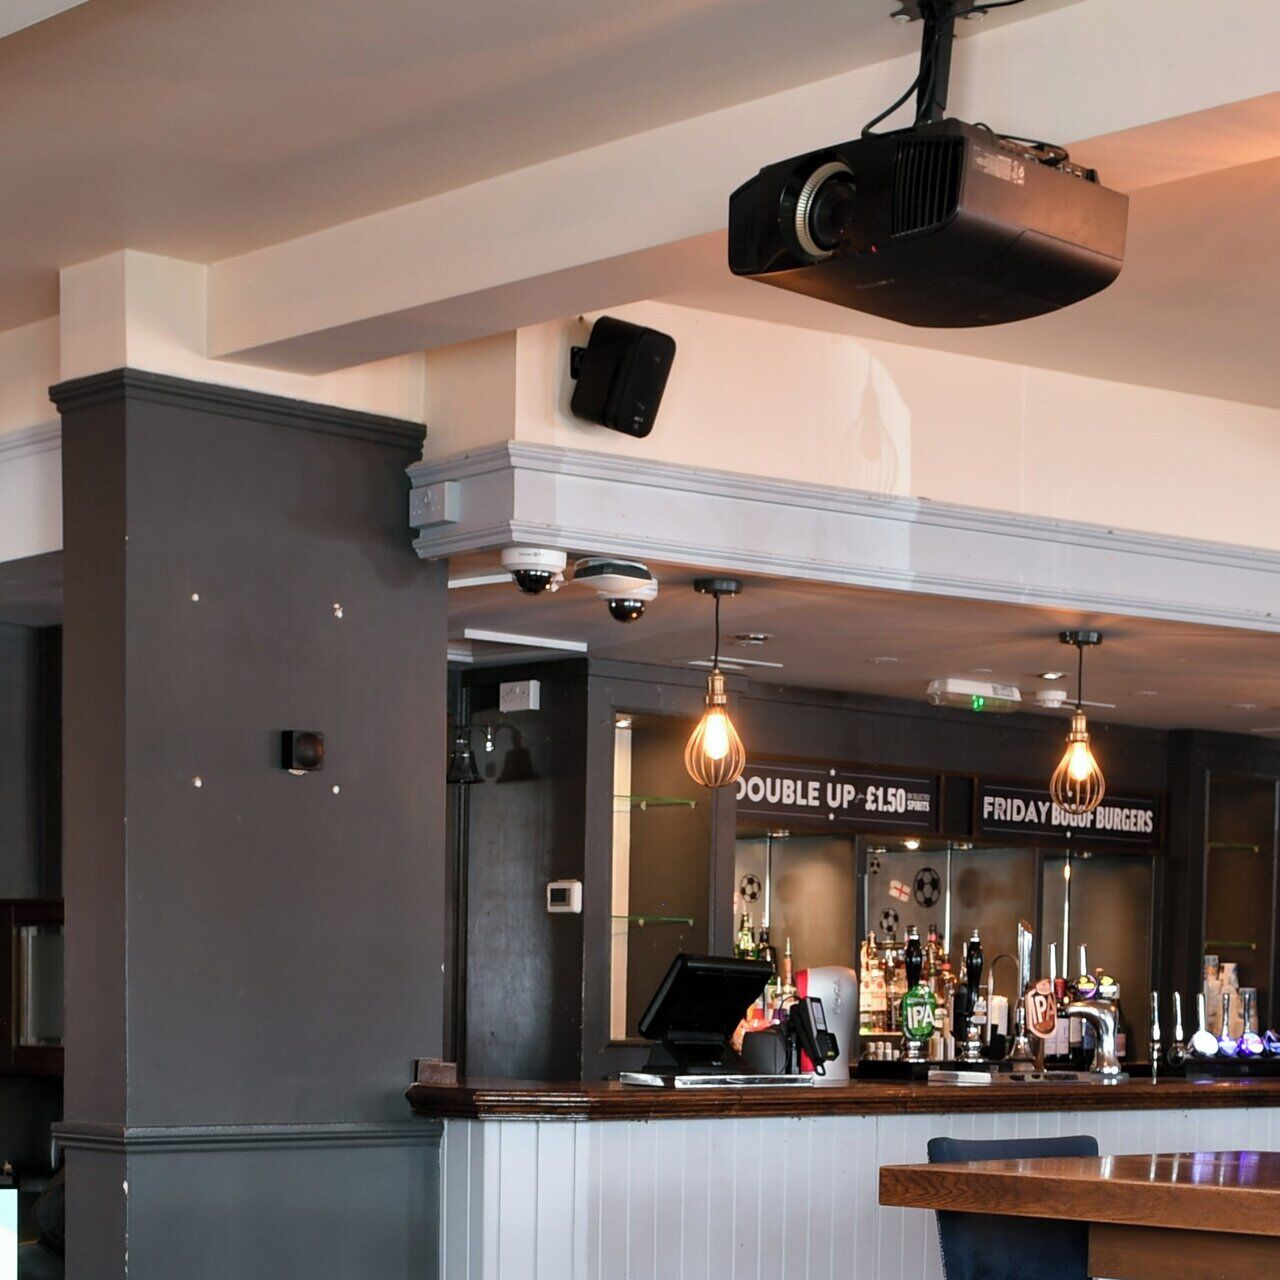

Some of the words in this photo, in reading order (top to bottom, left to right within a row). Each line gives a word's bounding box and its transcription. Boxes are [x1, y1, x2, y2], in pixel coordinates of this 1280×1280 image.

[736, 776, 820, 806] DOUBLE
[827, 783, 855, 809] UP
[865, 786, 906, 813] £1.50
[907, 800, 930, 811] SPIRITS
[983, 796, 1050, 824] FRIDAY
[1096, 806, 1153, 833] BURGERS
[907, 1004, 935, 1029] IPA
[1032, 994, 1057, 1026] IPA
